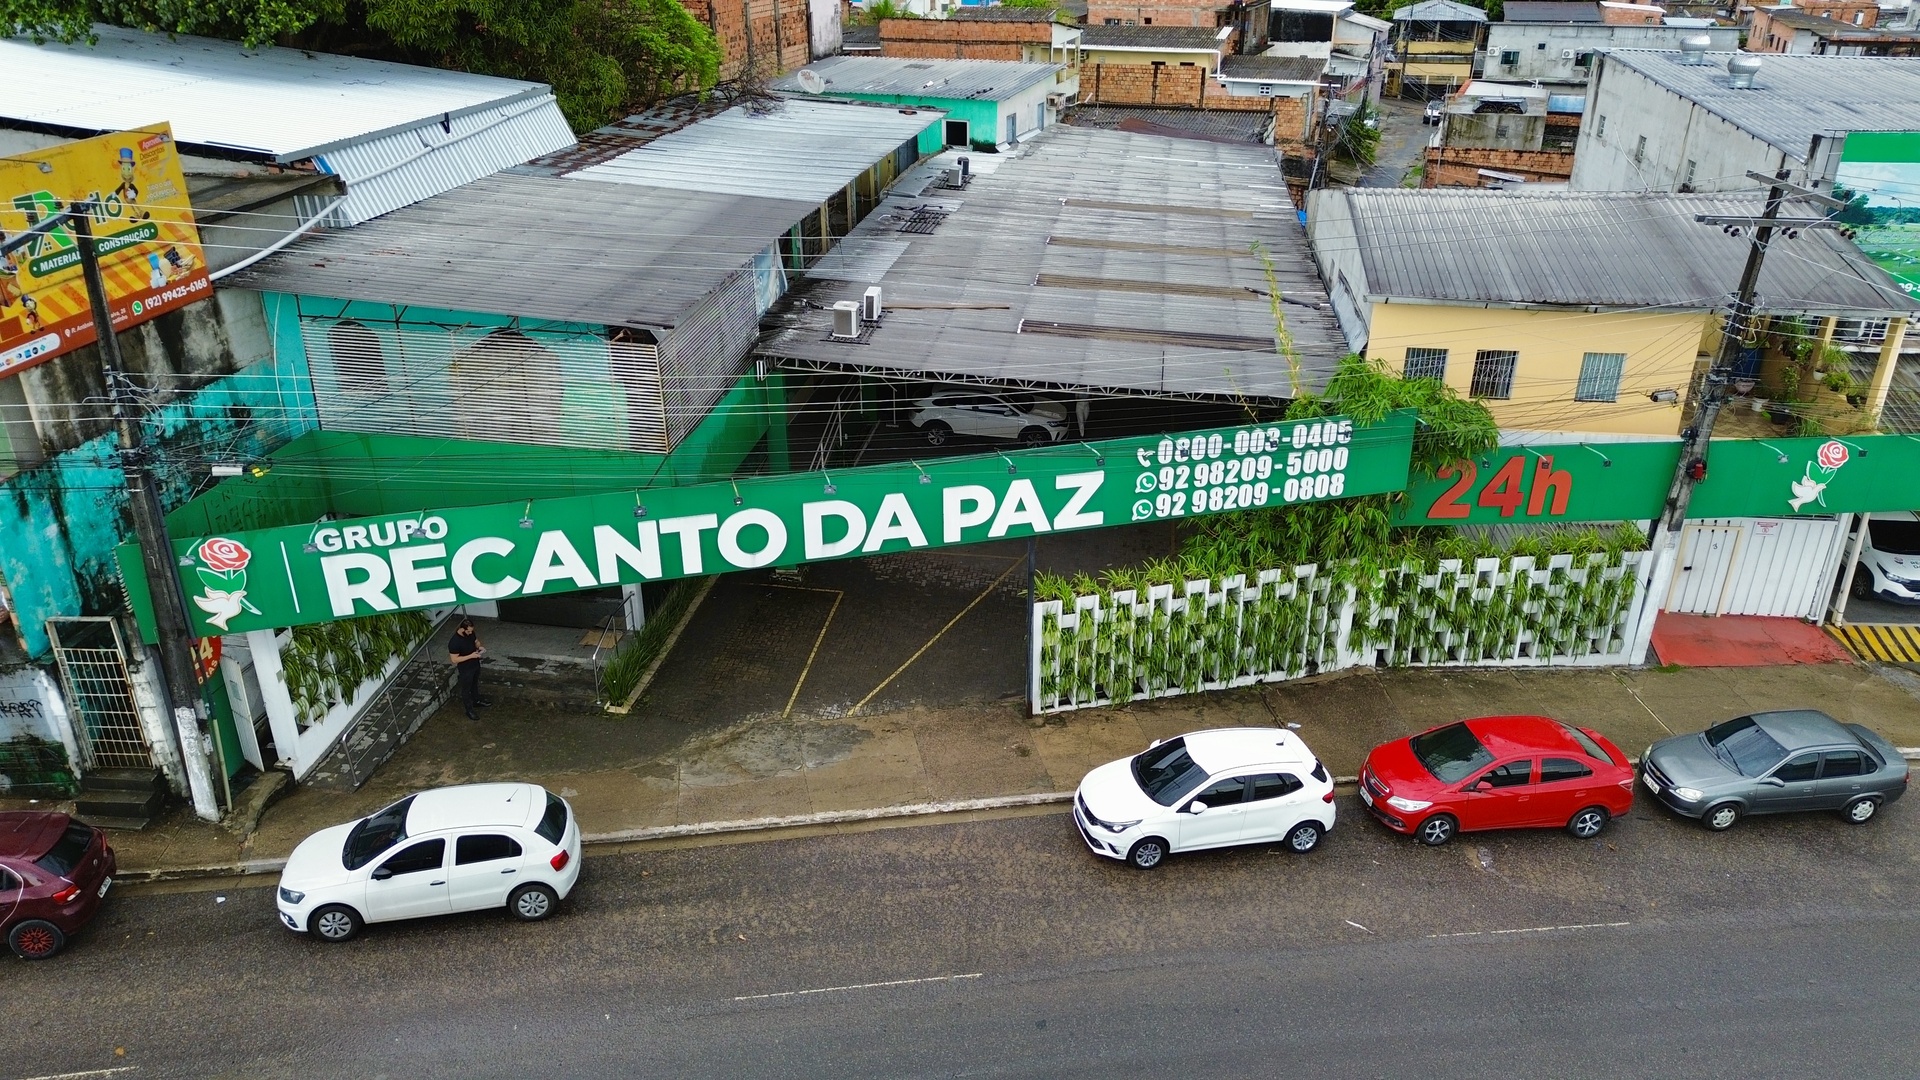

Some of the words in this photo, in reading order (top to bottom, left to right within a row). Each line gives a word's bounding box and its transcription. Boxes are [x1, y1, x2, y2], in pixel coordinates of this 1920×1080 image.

[140, 146, 165, 160] Descontos
[98, 228, 150, 252] CONSTRUÇÃO
[145, 296, 162, 310] (92)
[162, 277, 208, 302] 99425-6168
[1157, 420, 1353, 465] 0800-003-0405
[1158, 465, 1190, 491] 92
[1427, 454, 1573, 518] 24h
[1155, 492, 1187, 518] 92
[314, 515, 449, 553] GRUPO
[320, 506, 788, 618] RECANTO
[802, 492, 929, 560] DA
[942, 470, 1105, 543] PAZ
